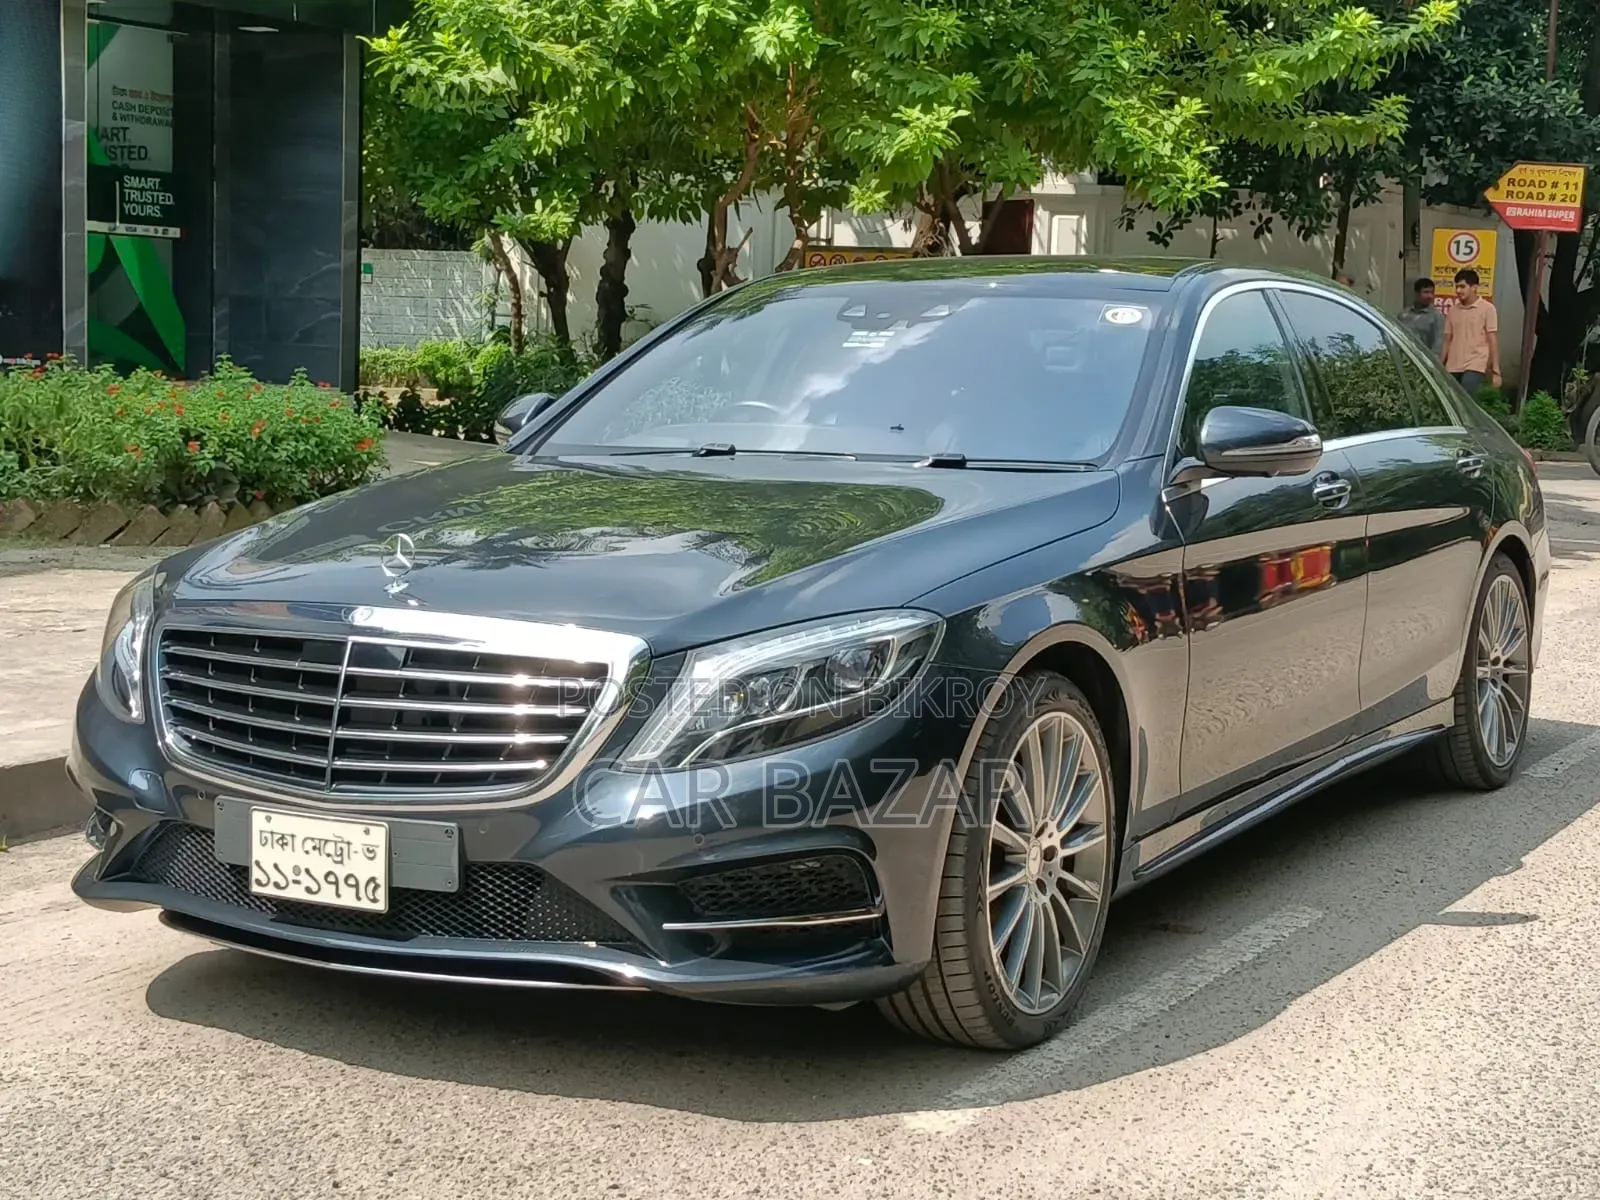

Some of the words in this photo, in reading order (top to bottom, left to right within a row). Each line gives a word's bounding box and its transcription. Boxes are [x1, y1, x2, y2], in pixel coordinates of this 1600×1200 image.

[112, 100, 136, 112] CASH
[112, 112, 117, 121] &
[123, 175, 163, 190] SMART.
[1507, 178, 1547, 189] ROAD
[1550, 180, 1559, 189] #
[1562, 181, 1579, 191] 11
[123, 189, 175, 205] TRUSTED.
[1505, 190, 1545, 201] ROAD
[1548, 193, 1557, 201] #
[1559, 193, 1577, 203] 20
[123, 202, 163, 218] YOURS.
[1547, 209, 1576, 219] SUPER
[1453, 240, 1474, 256] 15
[258, 828, 297, 853] ঢাকা
